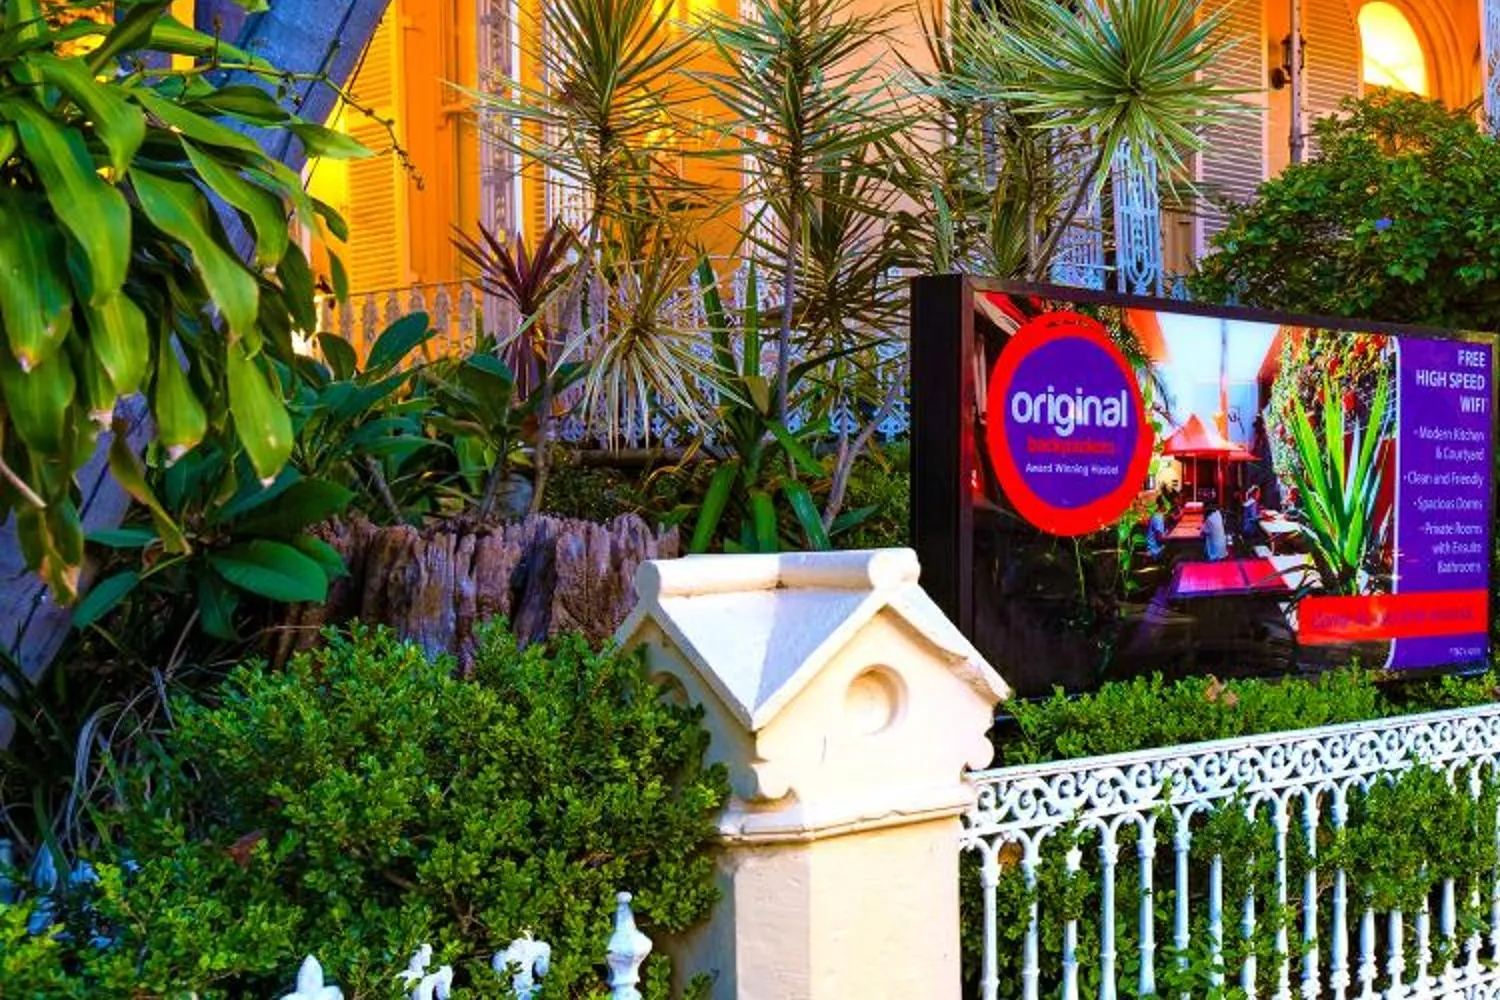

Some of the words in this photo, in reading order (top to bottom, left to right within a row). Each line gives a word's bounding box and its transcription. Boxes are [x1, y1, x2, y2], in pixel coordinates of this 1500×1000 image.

[1457, 349, 1486, 367] FREE
[1415, 369, 1447, 388] HIGH
[1449, 371, 1486, 391] SPEED
[1011, 385, 1128, 437] original
[1459, 395, 1485, 413] WIFI
[1419, 425, 1452, 440] Modern
[1453, 428, 1485, 441] Kitchen
[1443, 446, 1485, 463] Courtyard
[1026, 463, 1053, 473] Award
[1055, 463, 1089, 476] Winning
[1407, 470, 1432, 485] Clean
[1433, 471, 1450, 485] and
[1451, 471, 1484, 488] Friendly
[1417, 496, 1455, 511] Spacious
[1456, 497, 1483, 510] Dorms
[1424, 521, 1454, 535] Private
